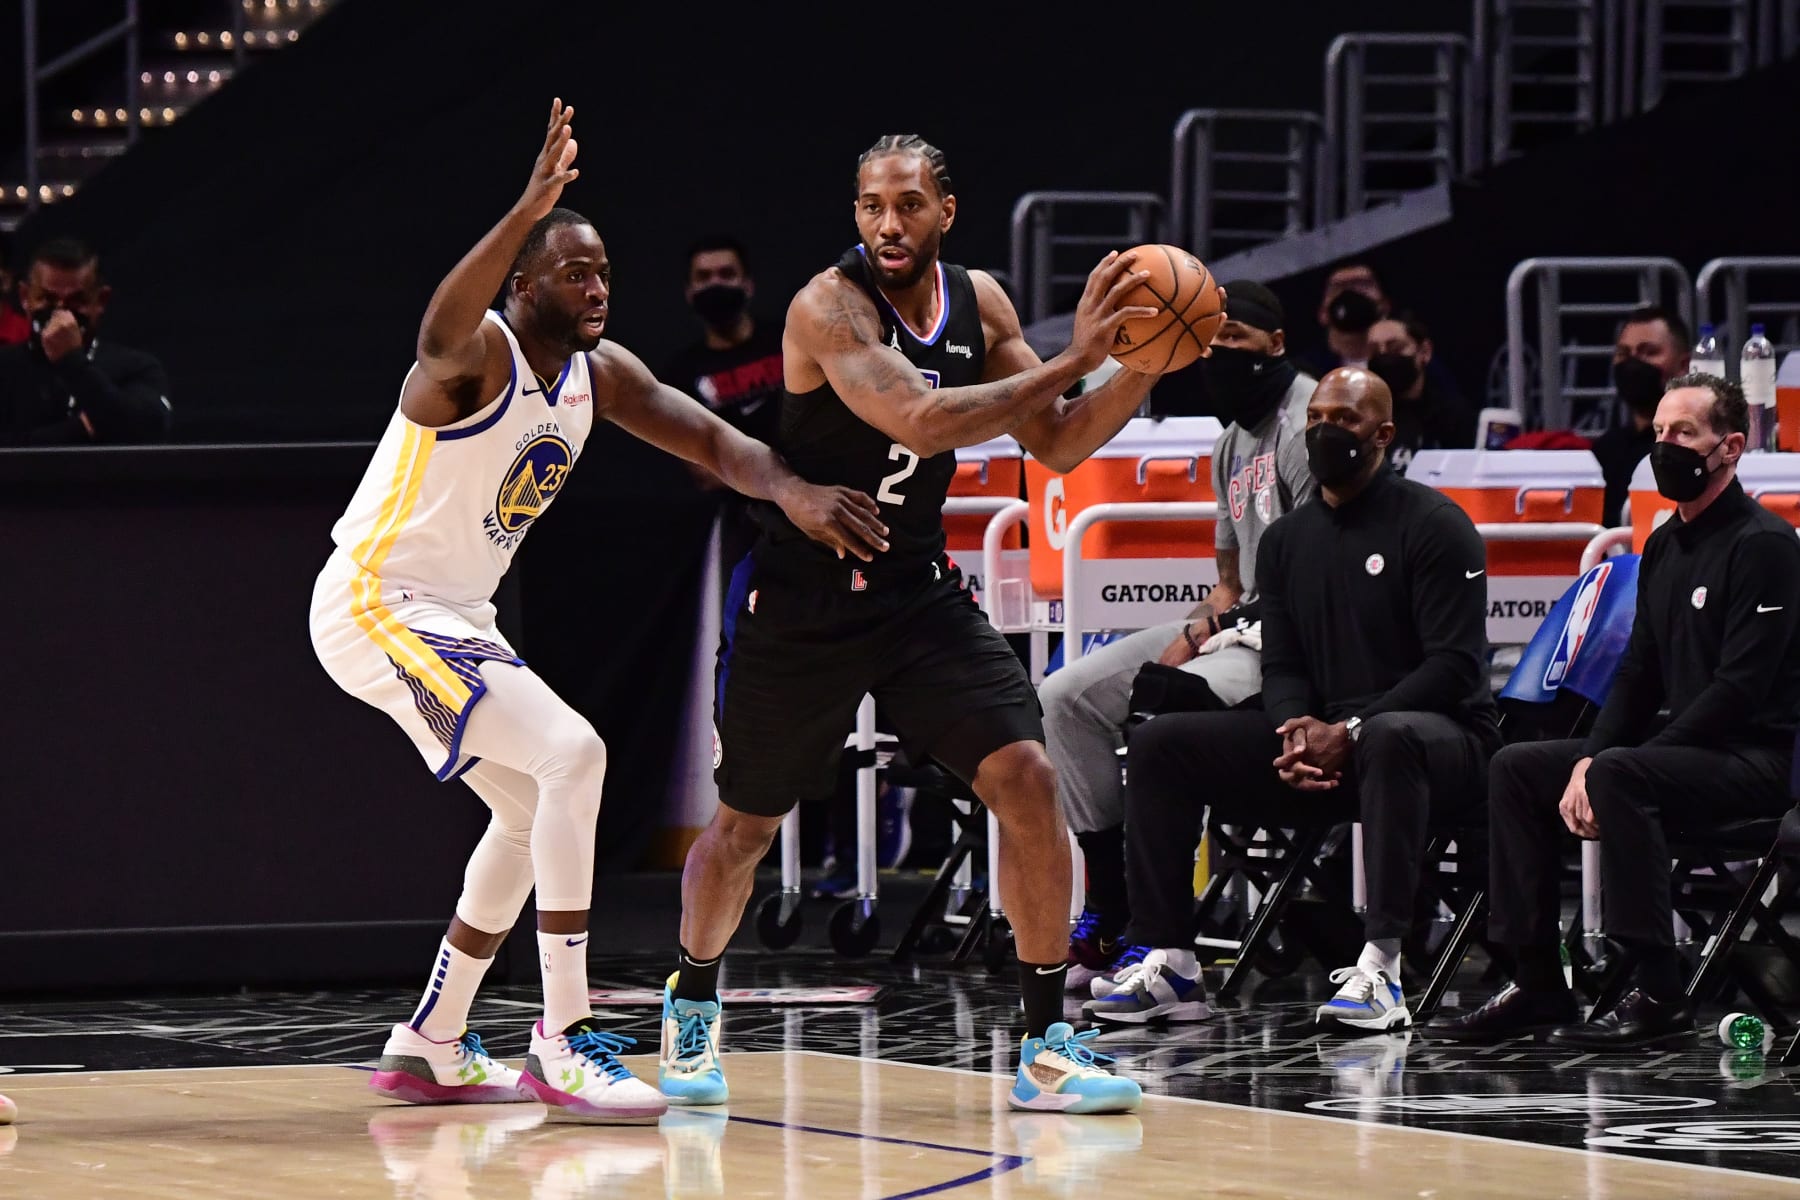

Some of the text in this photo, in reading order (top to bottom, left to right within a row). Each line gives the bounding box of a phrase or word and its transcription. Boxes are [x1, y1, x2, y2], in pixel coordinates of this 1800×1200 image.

[945, 339, 973, 359] honey
[515, 422, 560, 451] GOLDEN
[538, 464, 569, 491] 23
[876, 443, 919, 506] 2
[1044, 477, 1067, 552] G
[1101, 584, 1217, 603] GATORAD
[1485, 600, 1559, 618] ATOR
